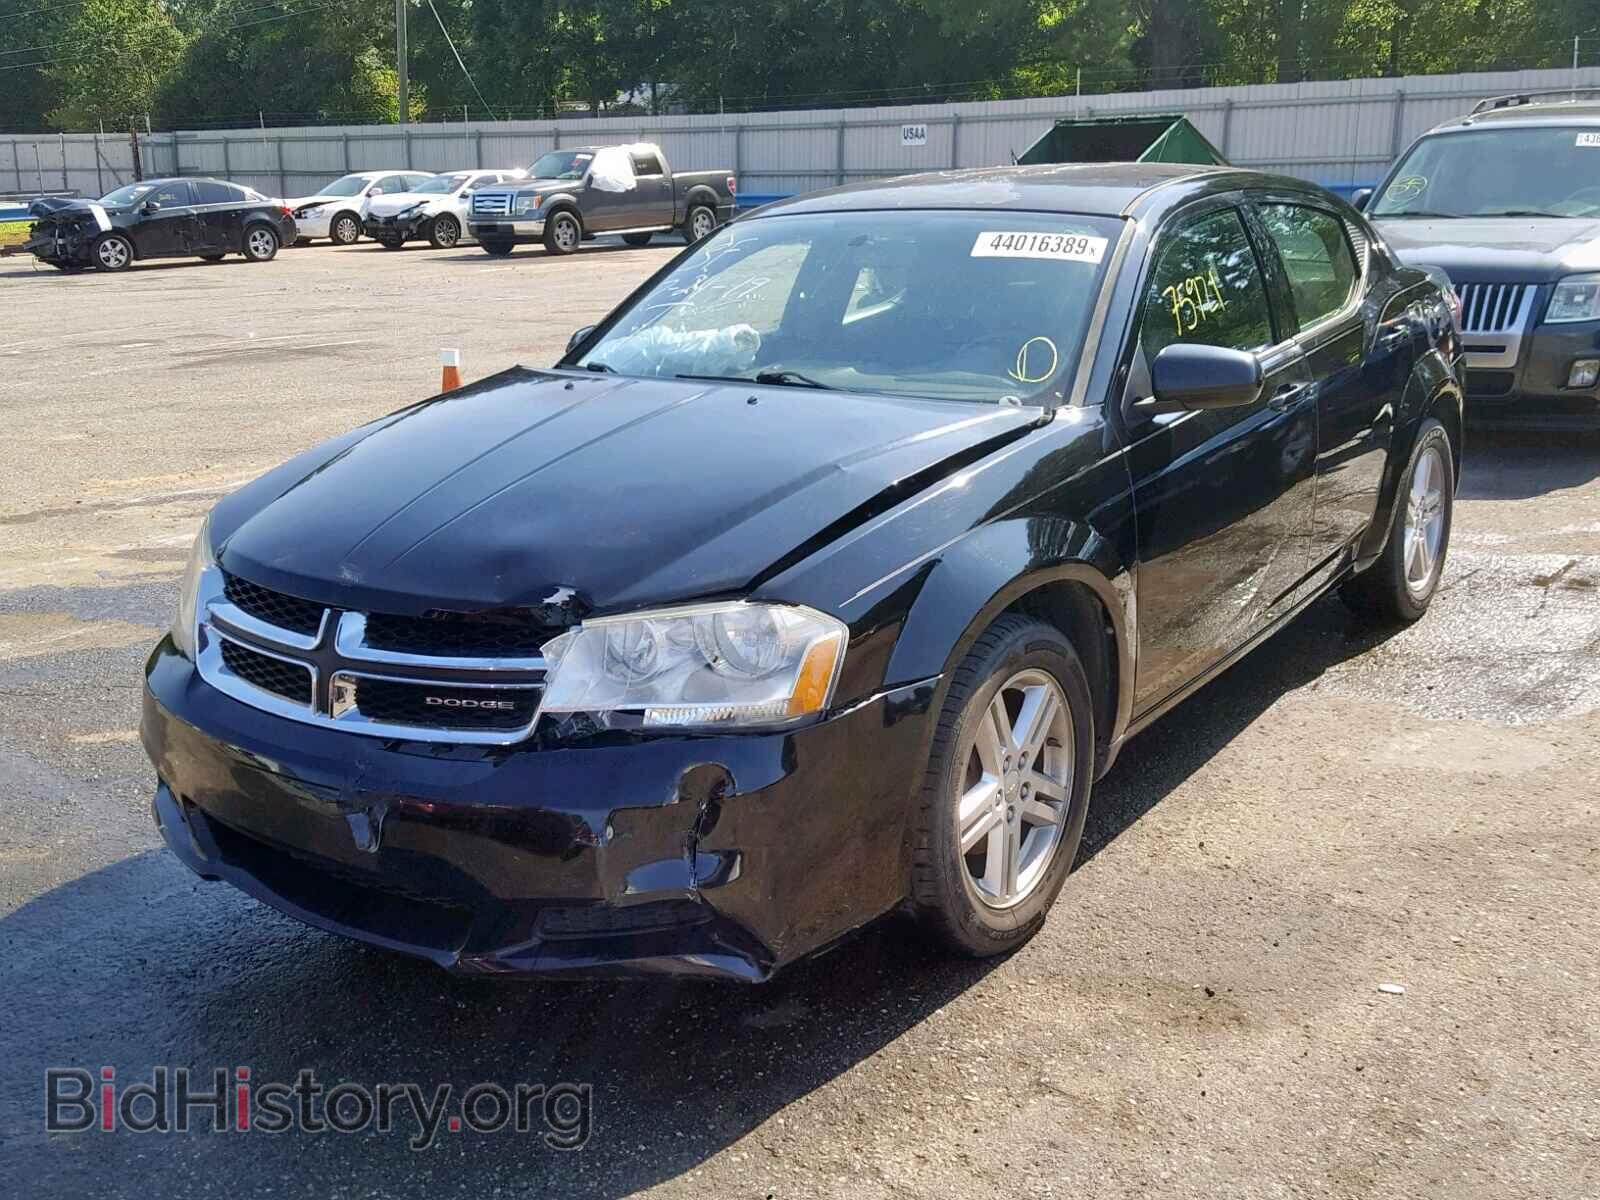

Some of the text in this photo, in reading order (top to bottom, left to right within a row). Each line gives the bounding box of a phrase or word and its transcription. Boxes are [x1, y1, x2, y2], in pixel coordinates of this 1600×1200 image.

[903, 127, 926, 140] USAA
[989, 233, 1090, 255] 44016389
[425, 696, 515, 710] DODGE
